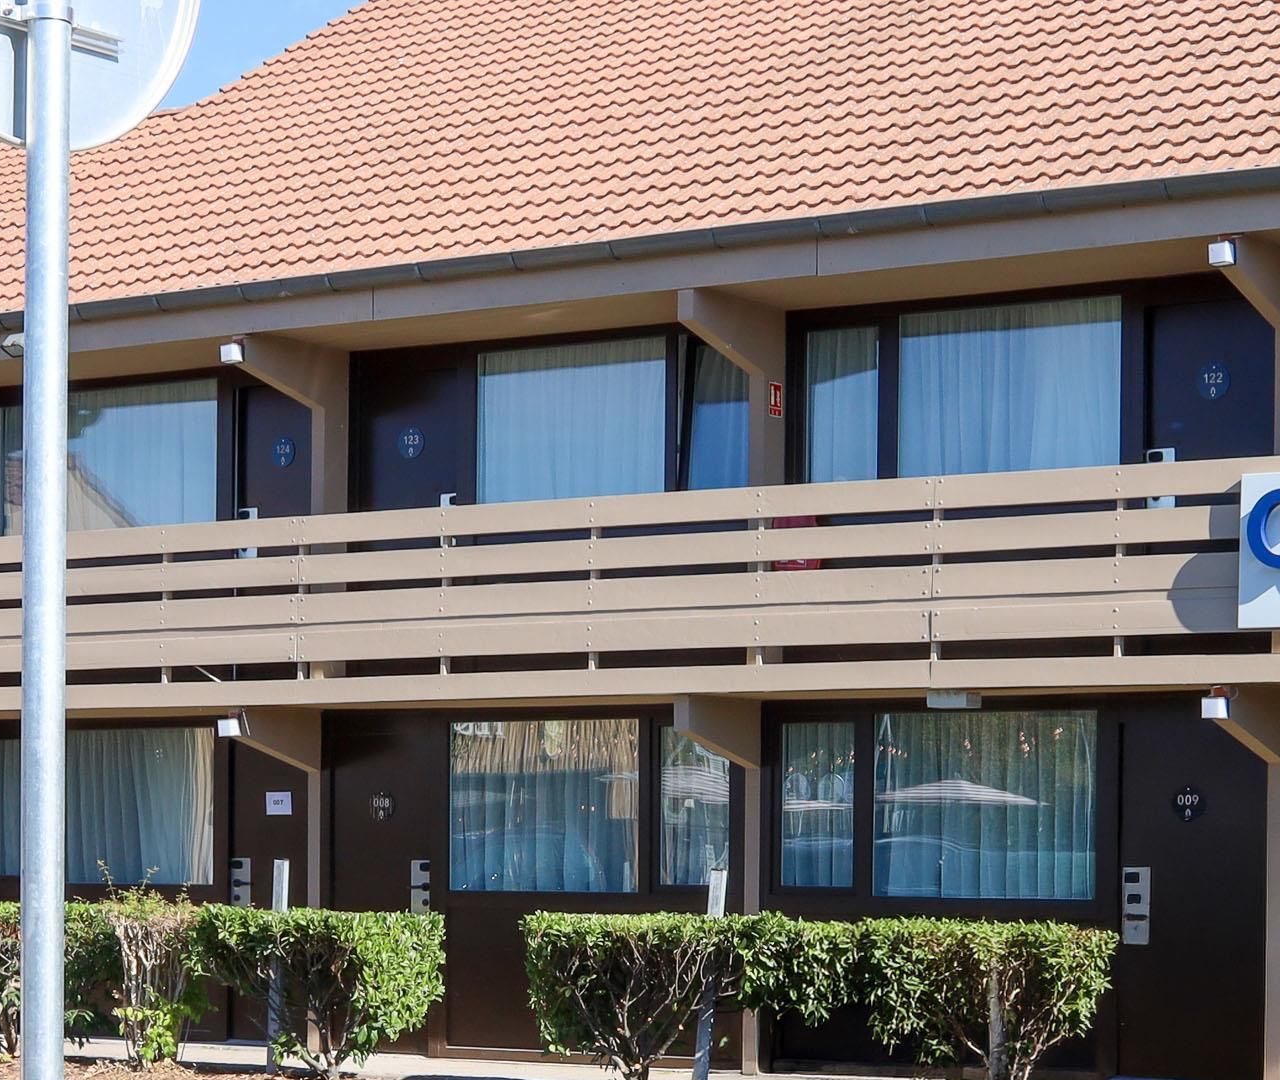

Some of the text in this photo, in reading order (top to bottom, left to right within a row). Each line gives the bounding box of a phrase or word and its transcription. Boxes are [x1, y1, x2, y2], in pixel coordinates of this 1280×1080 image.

[1203, 372, 1223, 384] 122
[403, 434, 419, 445] 123
[1177, 794, 1199, 806] 009
